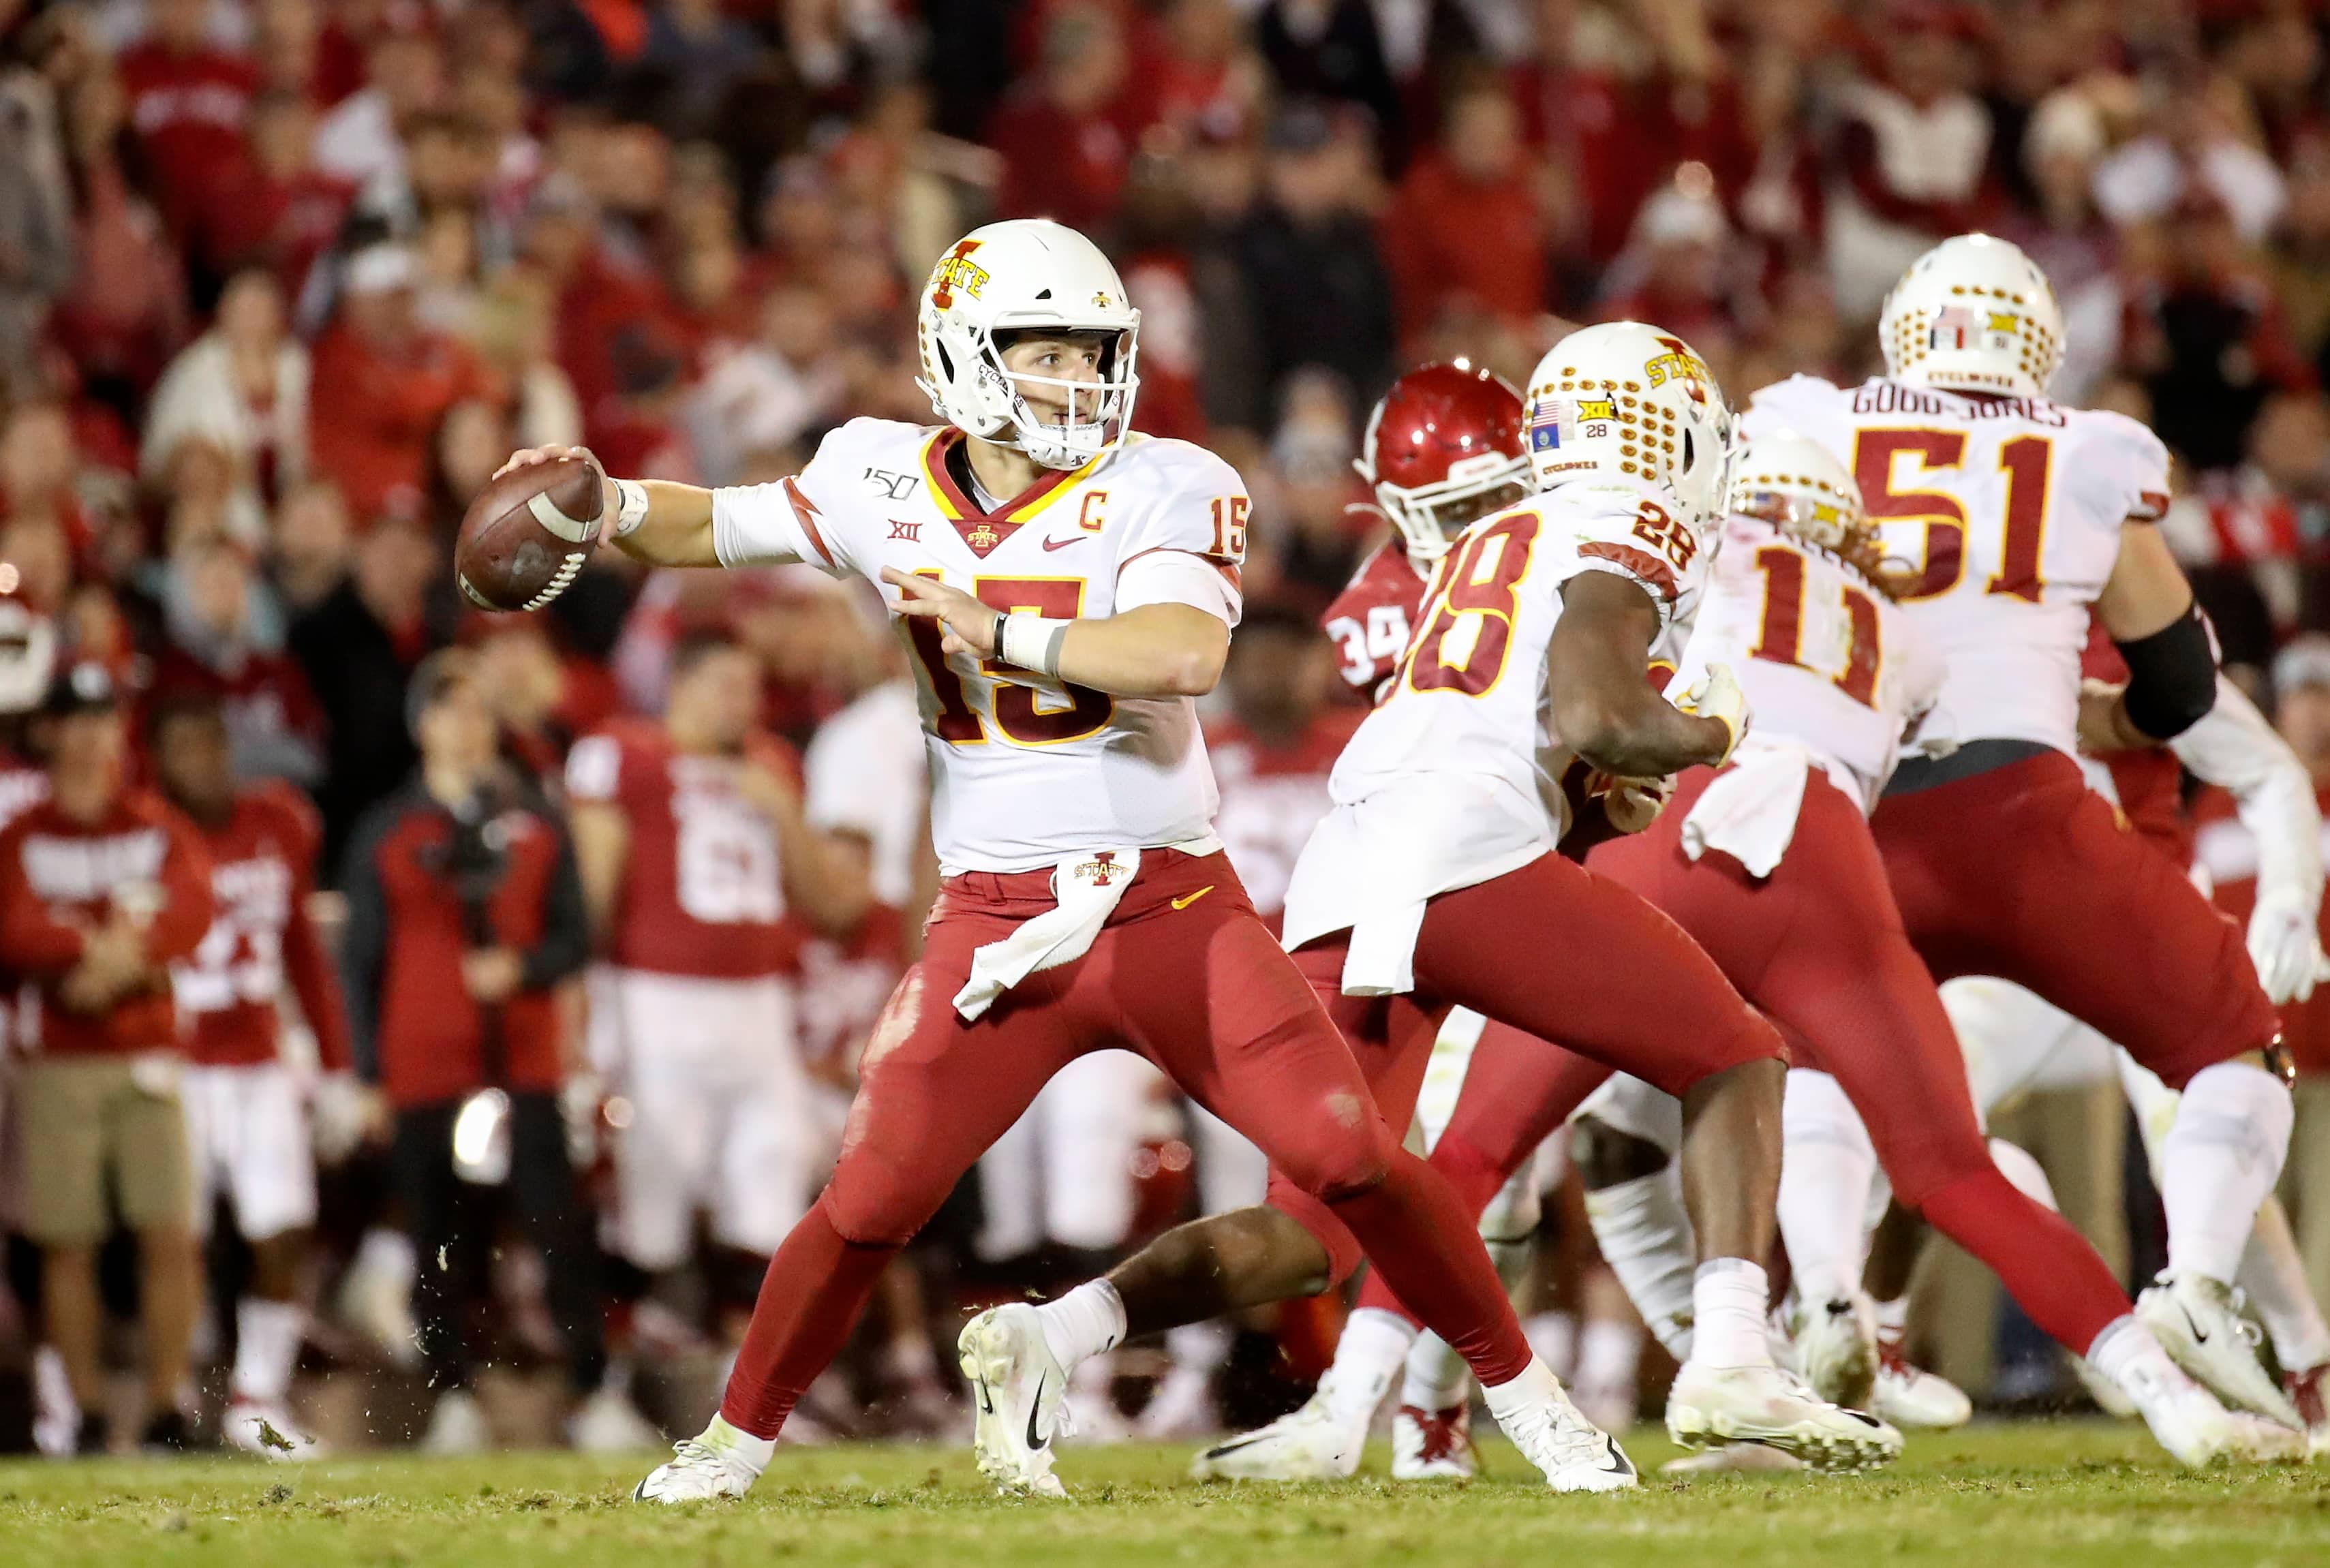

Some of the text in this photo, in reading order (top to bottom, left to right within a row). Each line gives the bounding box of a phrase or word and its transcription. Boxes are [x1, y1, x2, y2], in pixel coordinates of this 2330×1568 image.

[925, 257, 990, 301] TATE
[979, 364, 1024, 408] CYCLES
[1586, 424, 1607, 438] 28
[887, 519, 923, 542] XII
[1079, 490, 1109, 533] C
[1208, 495, 1248, 556] 15
[1631, 499, 1698, 572] 28
[1849, 427, 2054, 604] 51
[900, 568, 1116, 747] 15
[1325, 605, 1411, 686] 34
[1747, 544, 1882, 711] 11
